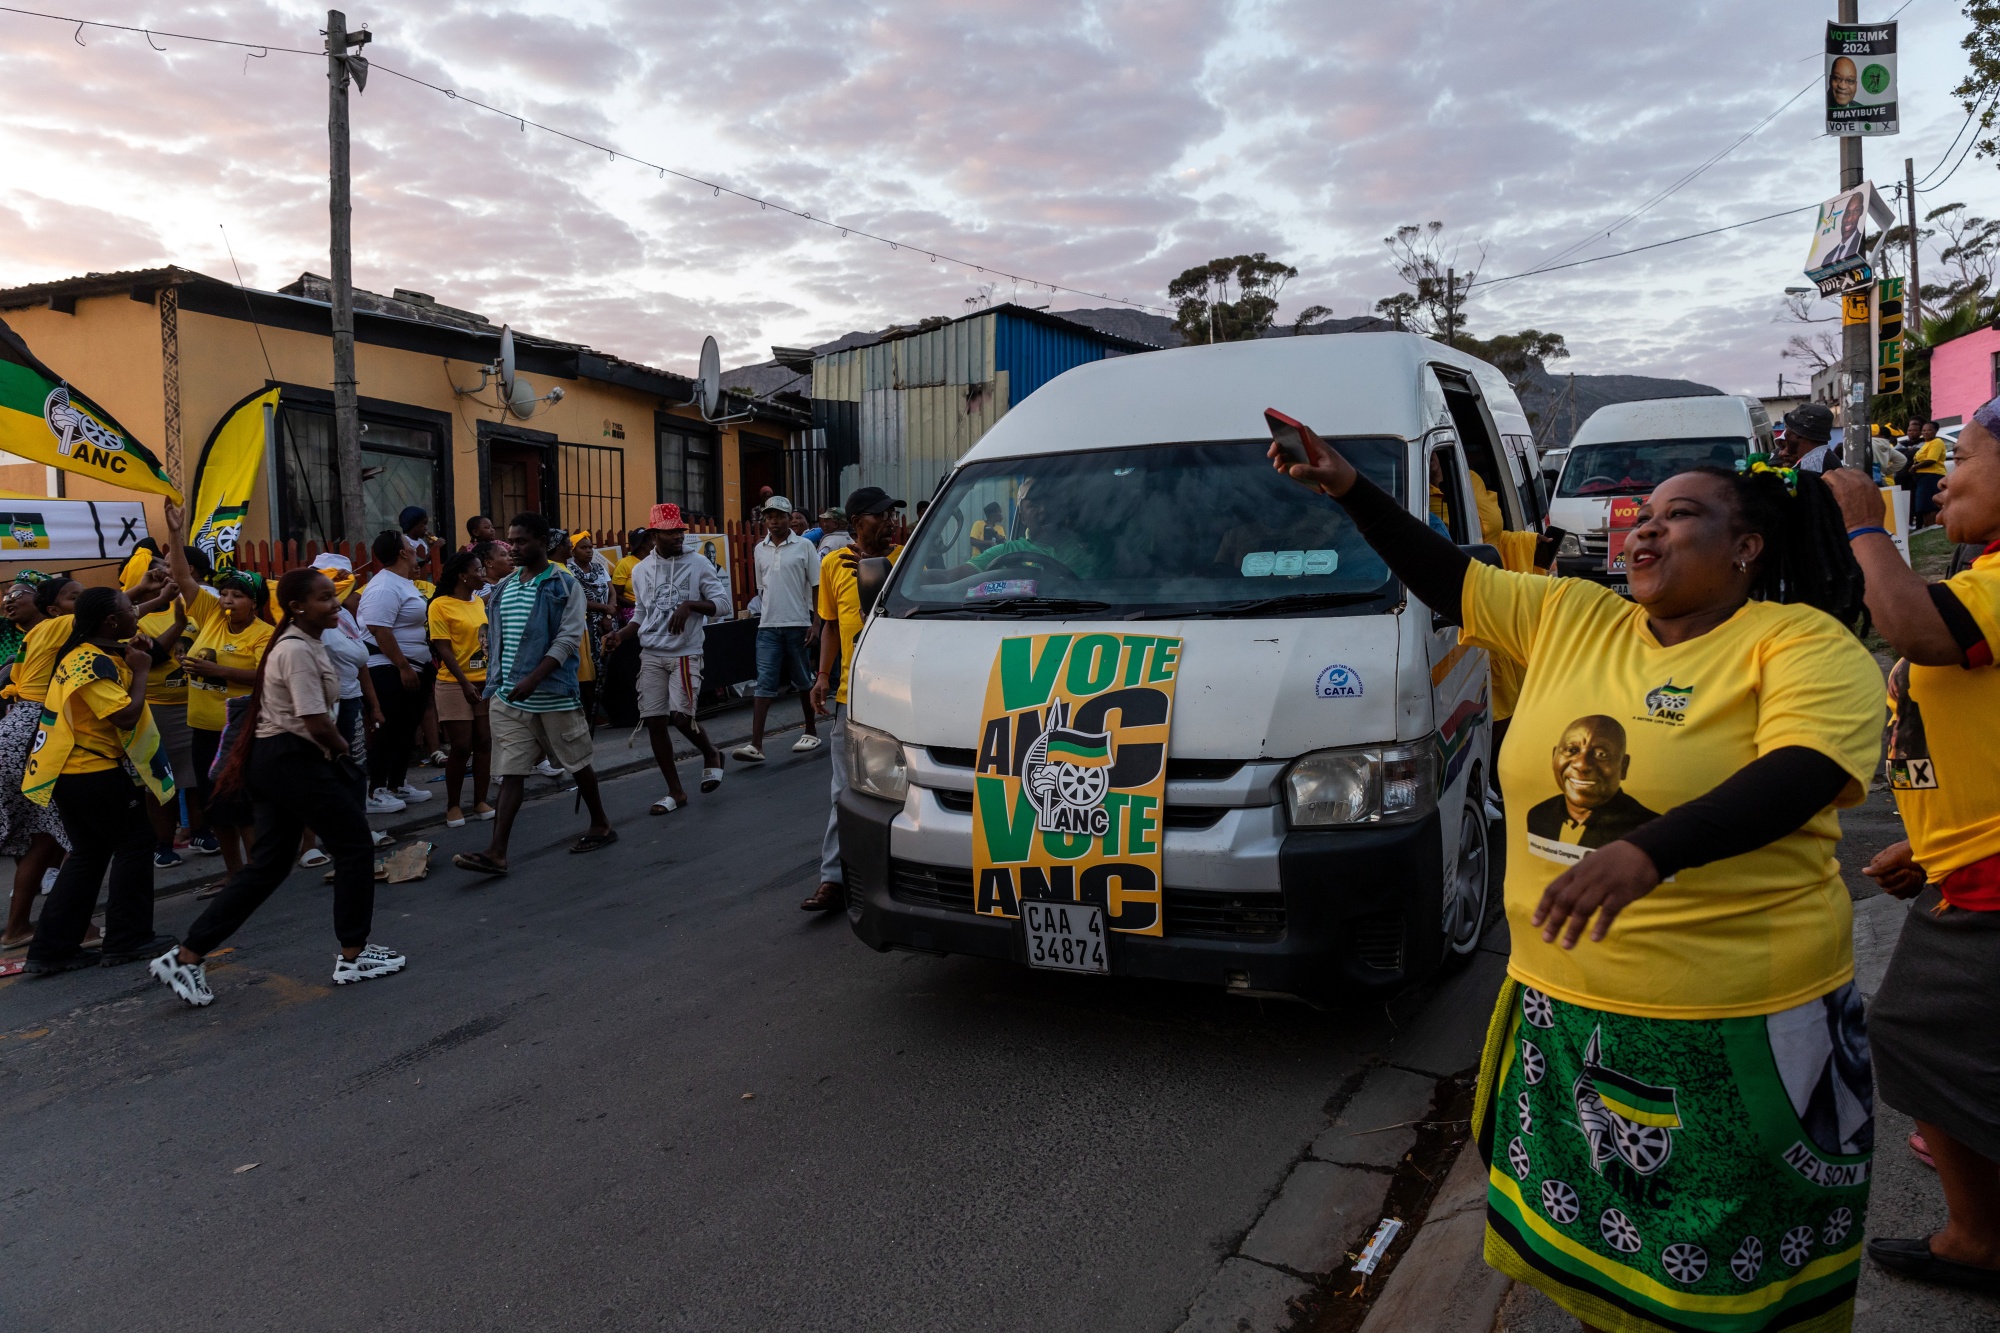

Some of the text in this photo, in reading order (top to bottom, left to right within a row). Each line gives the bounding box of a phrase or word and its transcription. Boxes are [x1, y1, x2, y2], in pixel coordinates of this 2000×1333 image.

[1830, 30, 1857, 41] VOTE
[1867, 30, 1889, 41] MK
[1843, 43, 1870, 53] 2024
[1832, 107, 1886, 119] #MAYIBUYE
[1829, 122, 1855, 131] VOTE
[1818, 276, 1840, 293] VOTE
[1852, 266, 1872, 282] ATM
[1879, 277, 1904, 301] TE
[1879, 341, 1900, 367] TE
[73, 443, 127, 474] ANC
[1614, 507, 1640, 518] VOT
[1613, 585, 1628, 594] CAA
[1001, 634, 1181, 712] VOTE
[1324, 687, 1355, 696] CATA
[1656, 709, 1685, 722] ANC
[977, 687, 1170, 789] ANC
[1055, 807, 1110, 834] ANC
[1542, 846, 1558, 855] National
[1559, 849, 1580, 859] Congress
[978, 862, 1158, 931] ANC
[1028, 906, 1101, 938] CAA 4
[1033, 935, 1104, 967] 34874
[1785, 1144, 1857, 1186] NELSON
[1604, 1161, 1674, 1210] ANC
